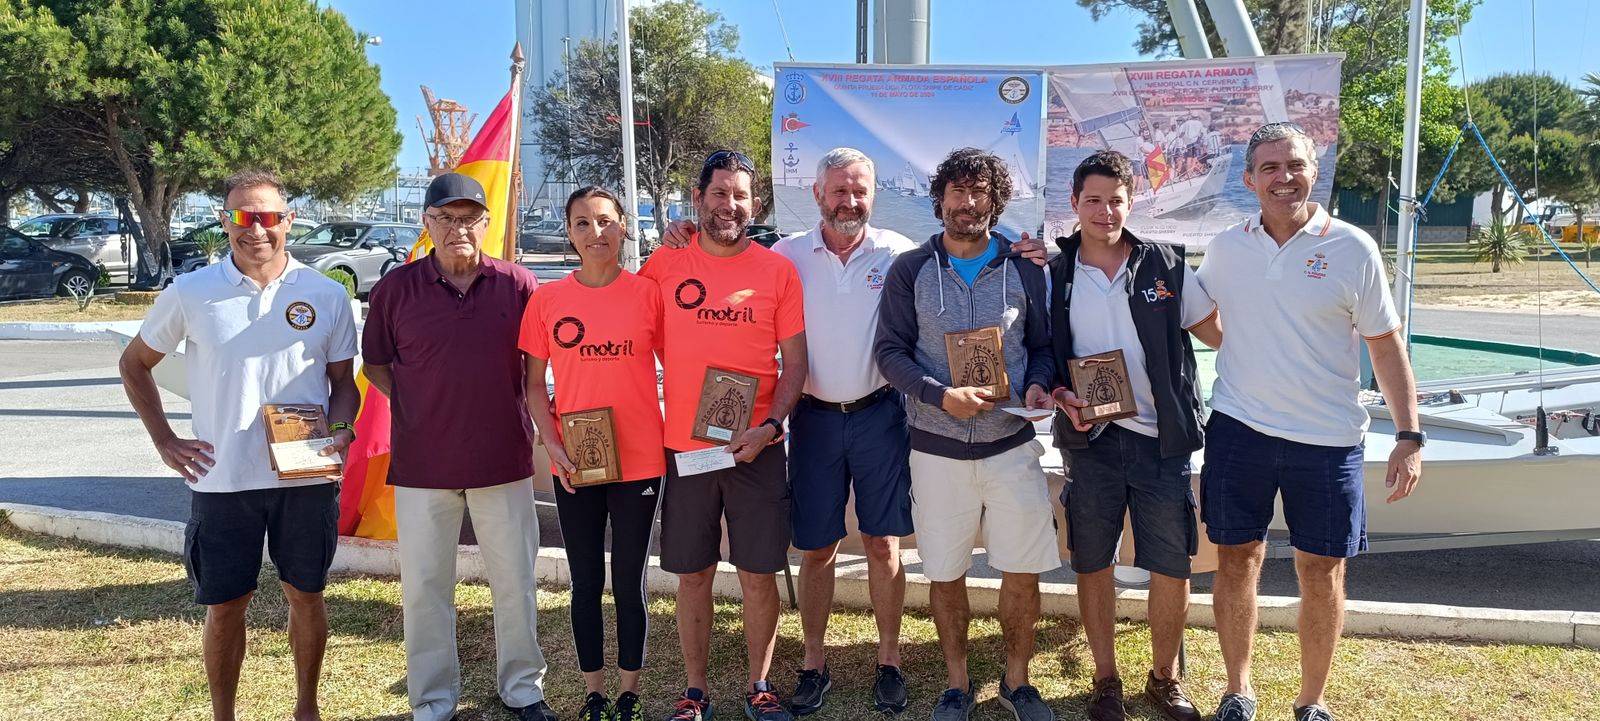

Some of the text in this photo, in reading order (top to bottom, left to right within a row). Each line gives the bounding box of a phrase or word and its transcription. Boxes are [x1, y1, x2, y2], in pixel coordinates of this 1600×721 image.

[822, 73, 988, 84] XVIII REGATA ARMADA ESPAÑOLA
[1130, 68, 1254, 80] XVIII REGATA ARMADA
[697, 306, 757, 324] motril
[580, 340, 634, 356] motril
